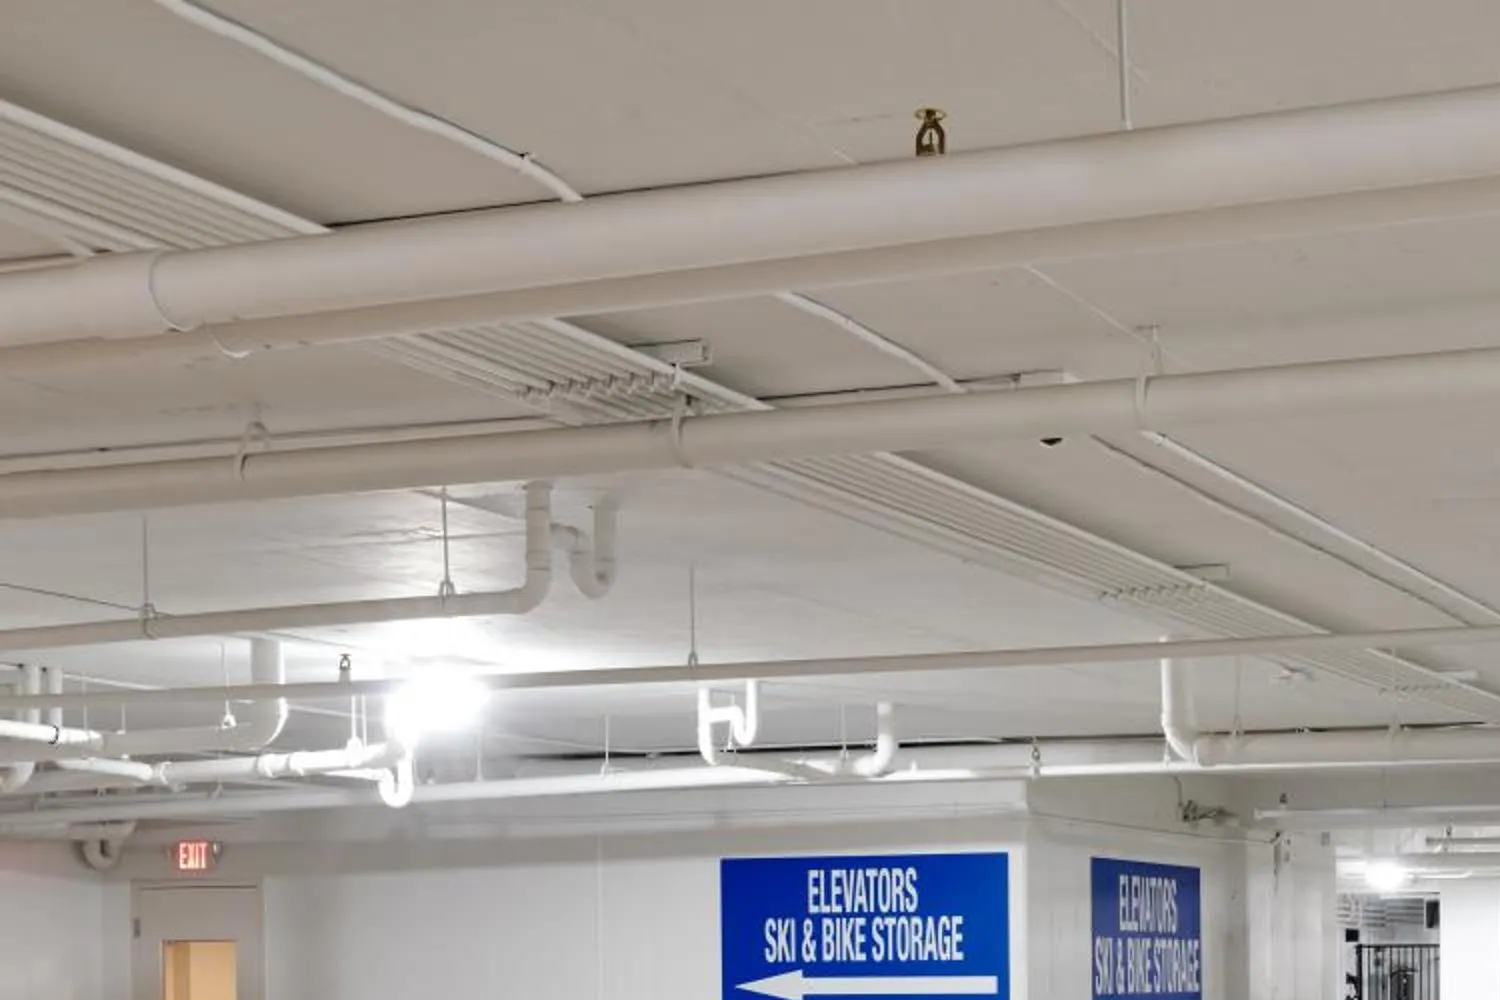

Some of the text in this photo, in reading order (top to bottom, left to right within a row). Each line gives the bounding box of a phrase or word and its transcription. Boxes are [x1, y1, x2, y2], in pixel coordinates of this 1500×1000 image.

[179, 842, 208, 869] EXIT
[807, 866, 919, 914] ELEVATORS
[1119, 874, 1178, 933] ELEVATORS
[764, 915, 965, 963] SKI & BIKE STORAGE
[1095, 936, 1199, 995] SKI & BIKE STORAGE
